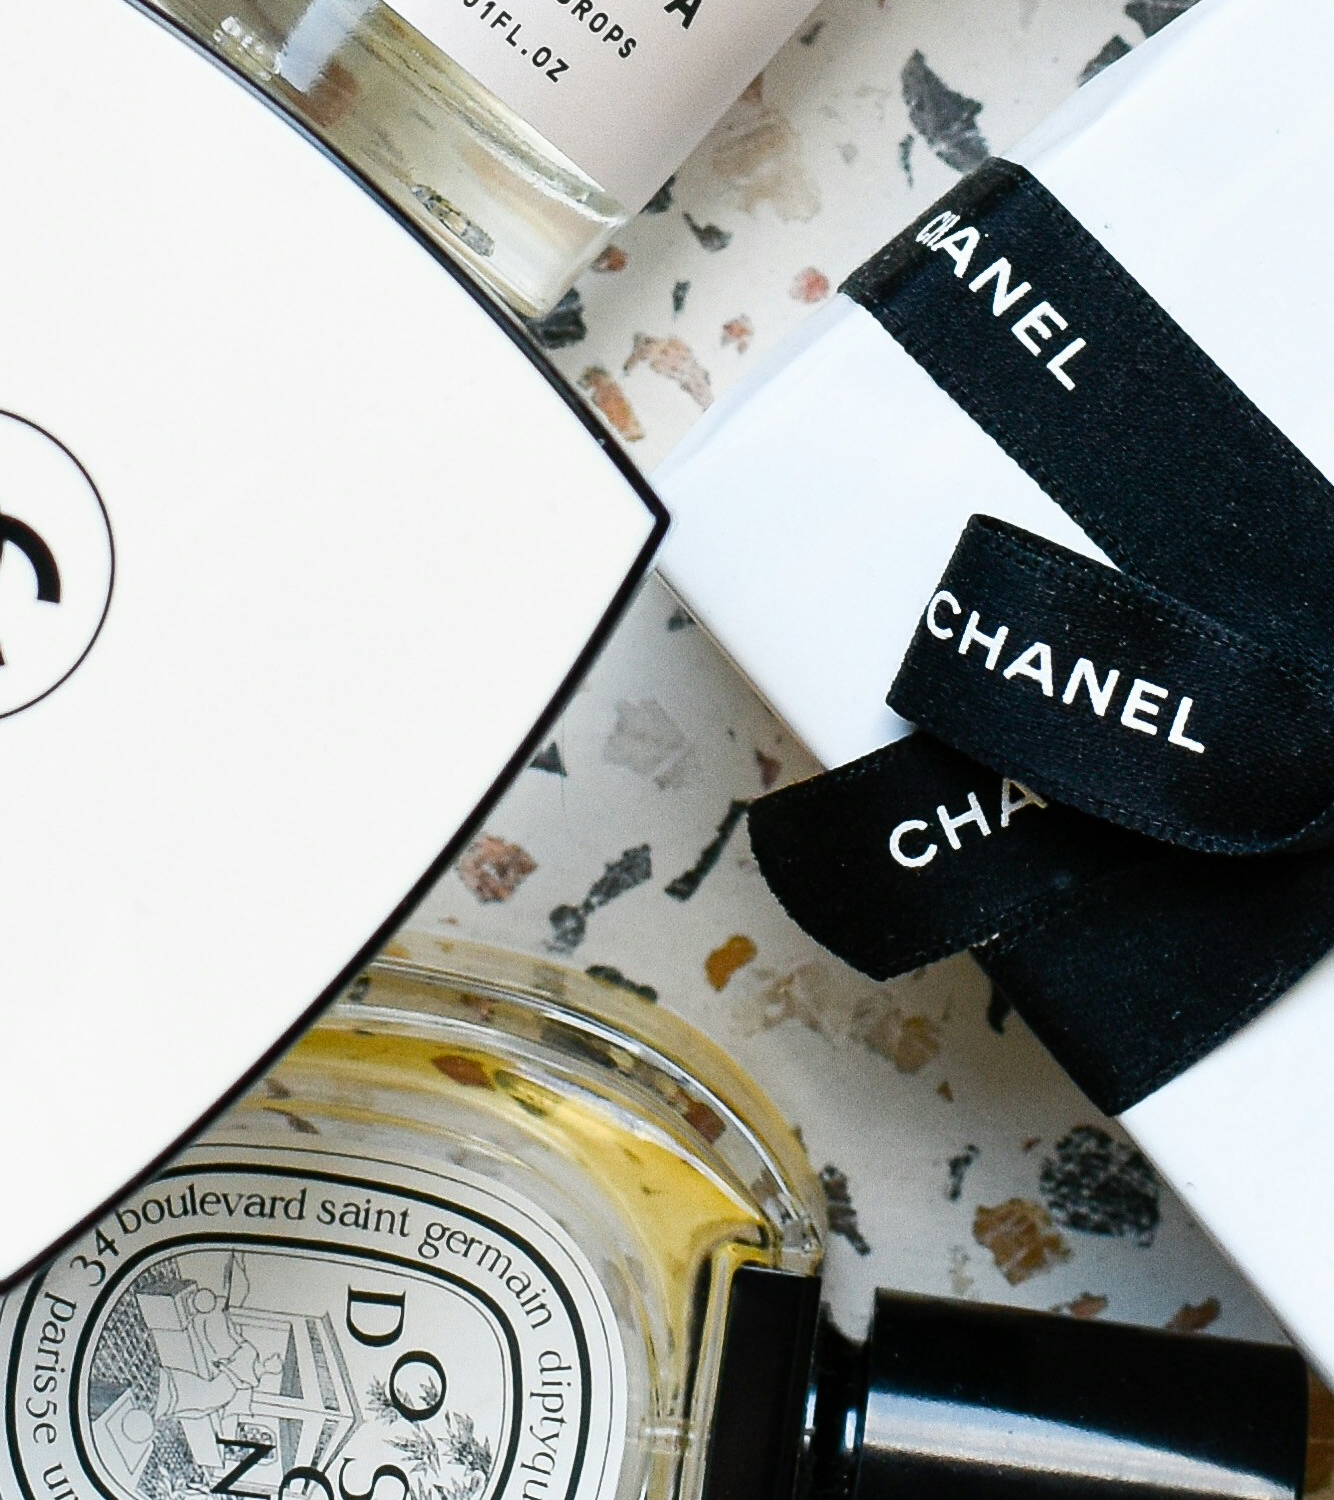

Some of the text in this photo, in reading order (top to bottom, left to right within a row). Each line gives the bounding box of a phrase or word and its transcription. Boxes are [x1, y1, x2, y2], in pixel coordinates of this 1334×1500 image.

[926, 590, 1206, 755] CHANEL
[69, 1225, 122, 1289] 34
[114, 1183, 308, 1236] boulevard
[315, 1196, 411, 1239] saint
[417, 1220, 555, 1332] germain
